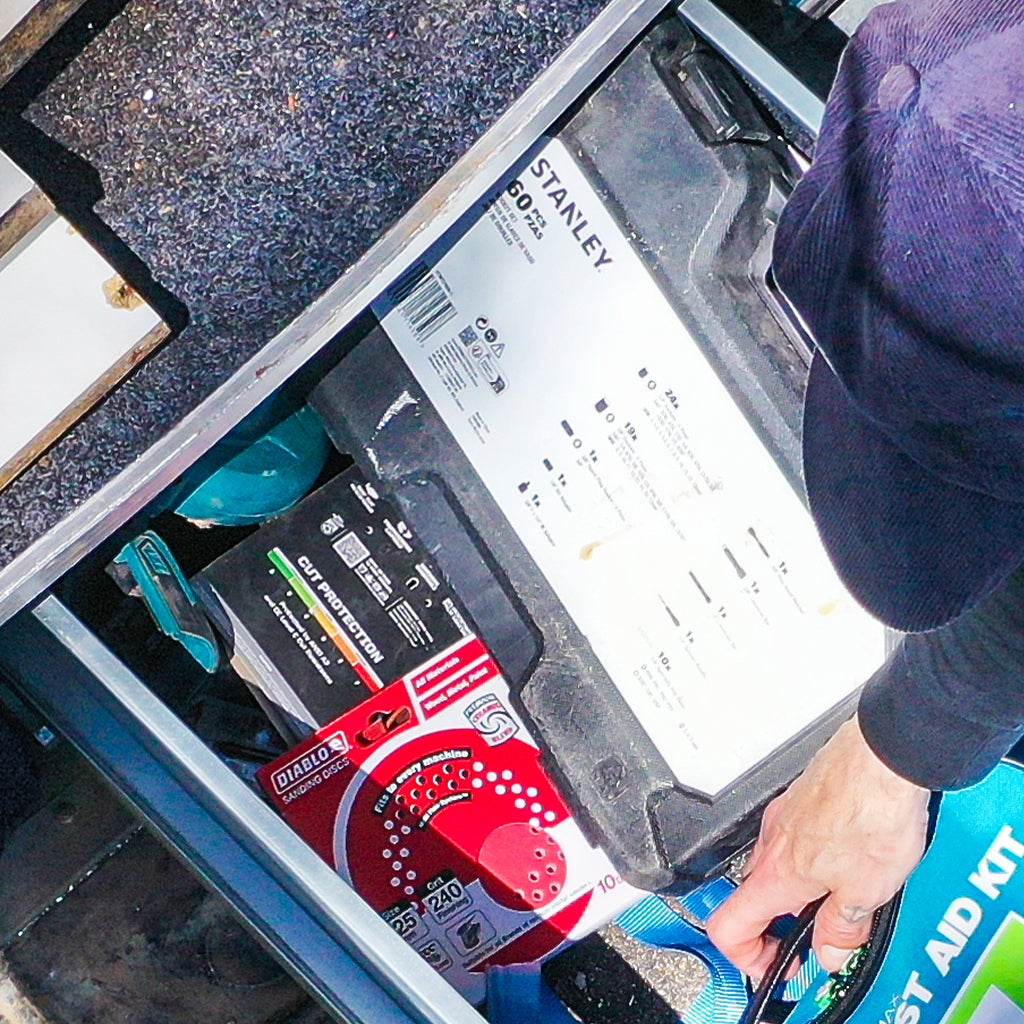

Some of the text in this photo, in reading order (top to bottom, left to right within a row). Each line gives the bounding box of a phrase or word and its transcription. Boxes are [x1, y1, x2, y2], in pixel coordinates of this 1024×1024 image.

[506, 180, 533, 211] 60
[524, 214, 543, 240] PZAS
[530, 158, 613, 268] STANLEY
[531, 208, 548, 228] PCS
[624, 422, 638, 441] 19x
[297, 556, 323, 582] CUT
[317, 581, 384, 664] PROTECTION
[277, 748, 329, 788] DIABLO
[282, 757, 350, 804] SANDING DISCS
[374, 750, 469, 813] Fits to every machine
[427, 877, 444, 890] Grit
[428, 883, 462, 912] 240
[597, 874, 616, 893] 10
[392, 912, 417, 933] 25
[924, 897, 983, 977] AID
